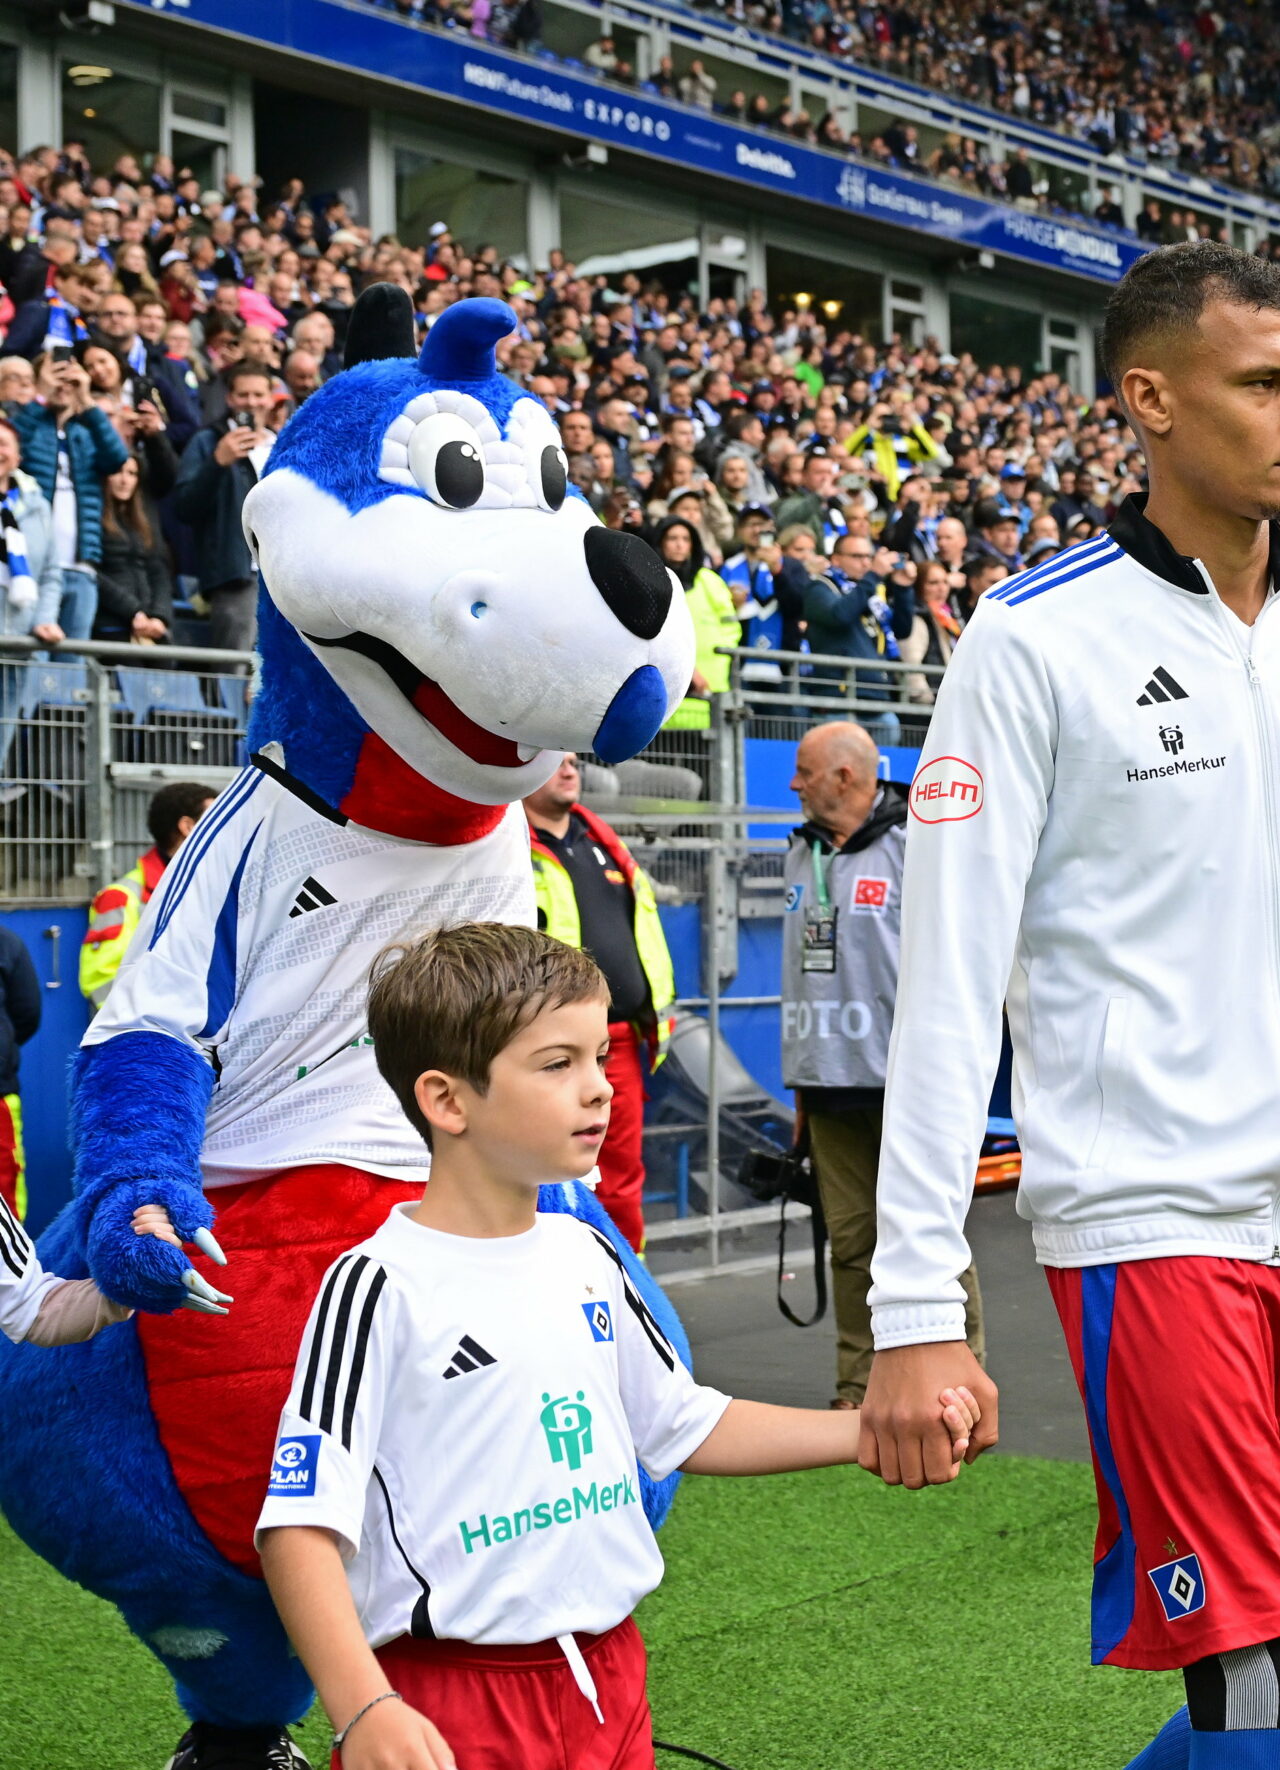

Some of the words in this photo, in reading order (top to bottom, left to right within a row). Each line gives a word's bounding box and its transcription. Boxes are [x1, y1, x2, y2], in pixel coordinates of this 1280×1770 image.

[584, 98, 671, 142] EXPORO
[1126, 756, 1227, 782] HanseMerkur
[782, 1000, 872, 1040] FOTO
[459, 1473, 637, 1555] HanseMerk
